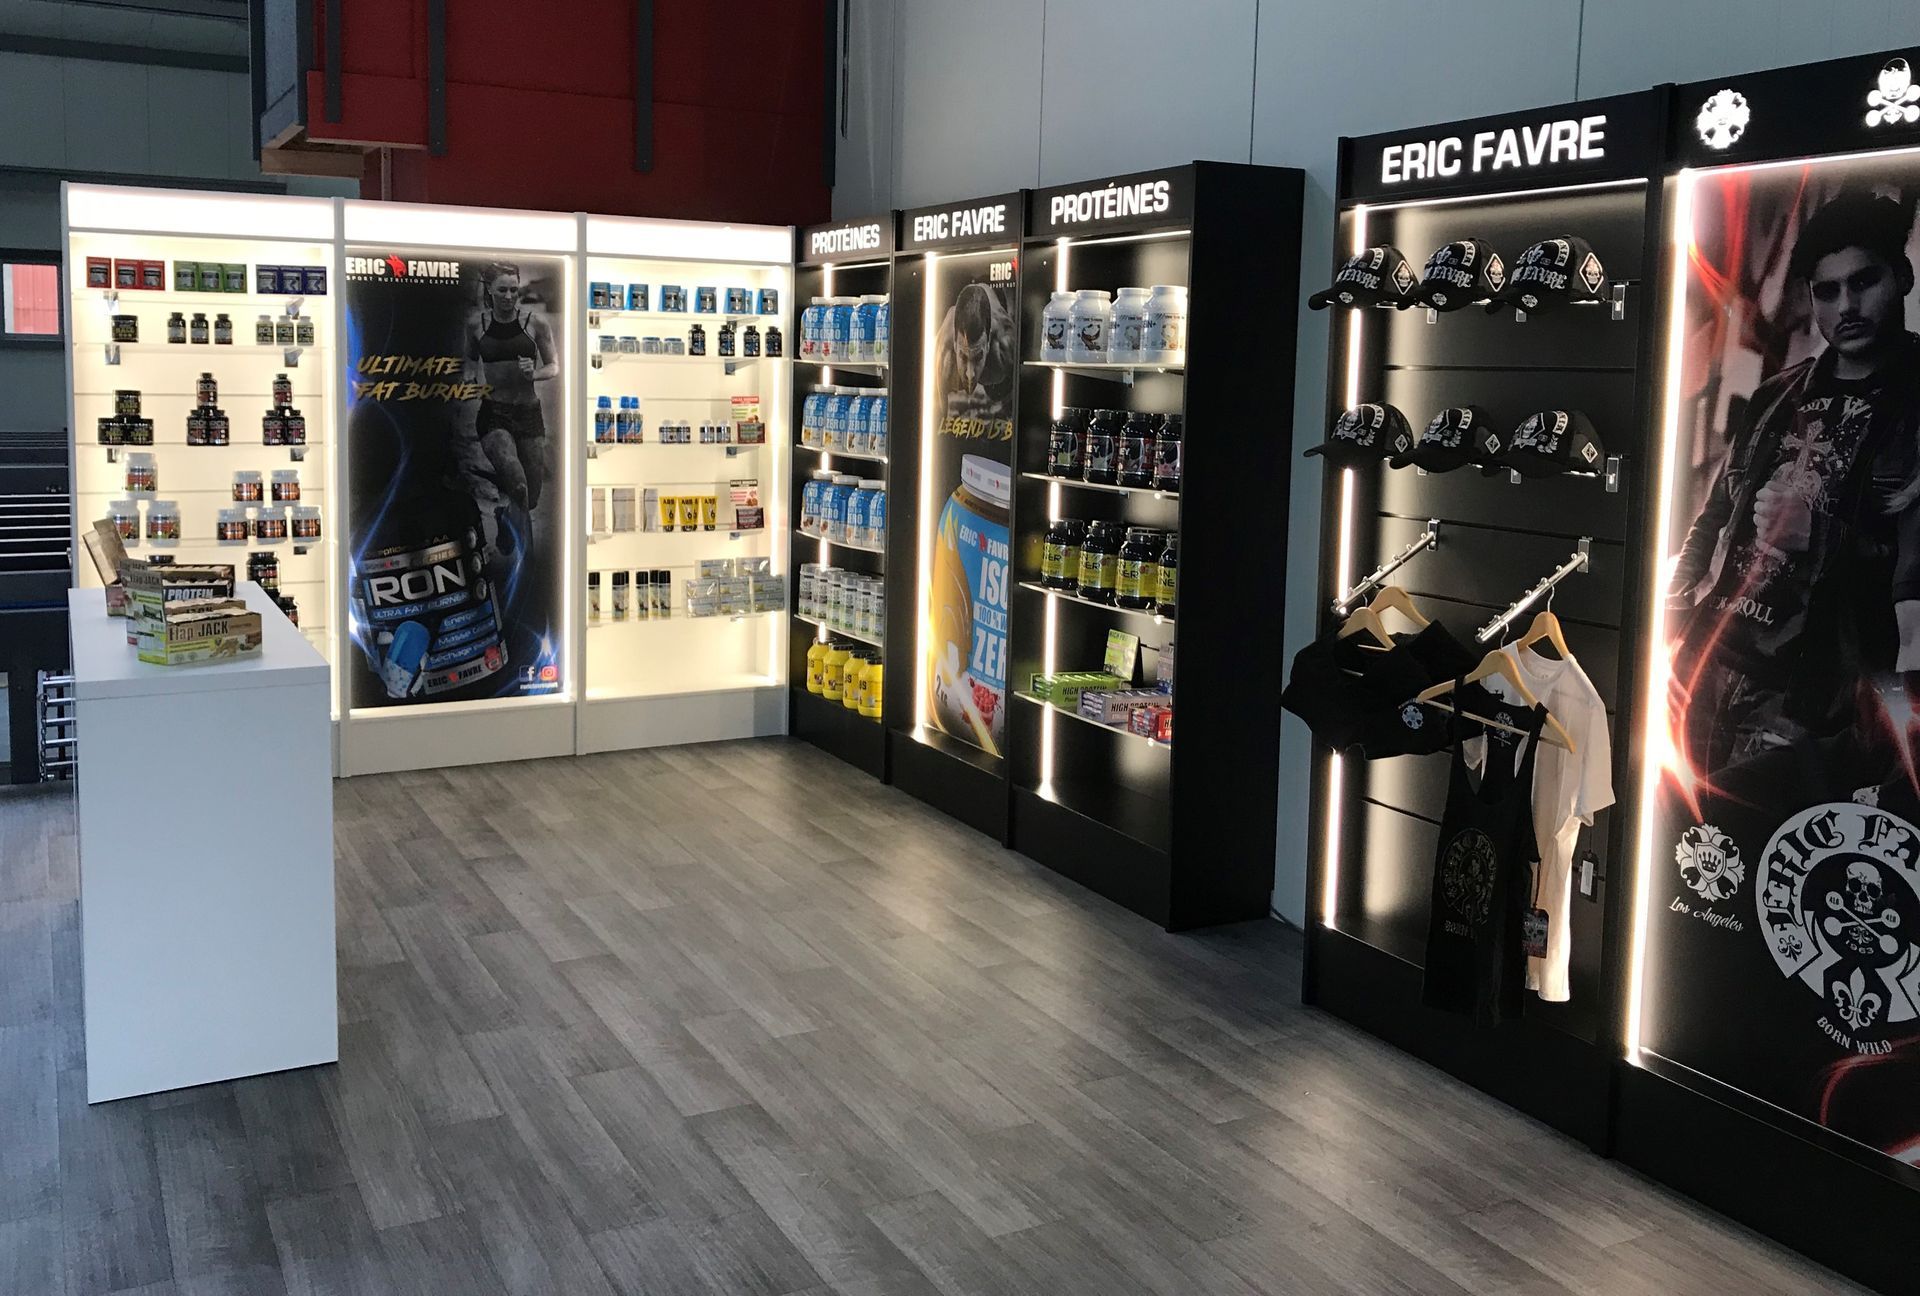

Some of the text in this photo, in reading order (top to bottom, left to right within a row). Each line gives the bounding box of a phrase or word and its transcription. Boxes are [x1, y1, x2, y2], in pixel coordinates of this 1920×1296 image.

[1381, 114, 1606, 184] ERIC FAVRE
[1051, 181, 1169, 225] PROTÉINES
[913, 204, 1005, 242] ERIC FAVRE
[811, 224, 880, 255] PROTÉINES
[345, 257, 460, 279] ERIC FAVRE
[989, 262, 1012, 281] ERIC
[357, 354, 465, 376] ULTIMATE
[357, 380, 495, 401] FAT BURNER
[937, 416, 985, 440] LEGEND
[959, 525, 978, 547] ERIC
[362, 559, 466, 606] IRON
[167, 588, 214, 601] PROTEIN
[373, 607, 402, 619] ULTRA
[197, 620, 229, 637] JACK
[1110, 702, 1129, 712] HIGH
[1668, 896, 1744, 932] Los Angeles
[1817, 1016, 1892, 1056] BORN WILD
